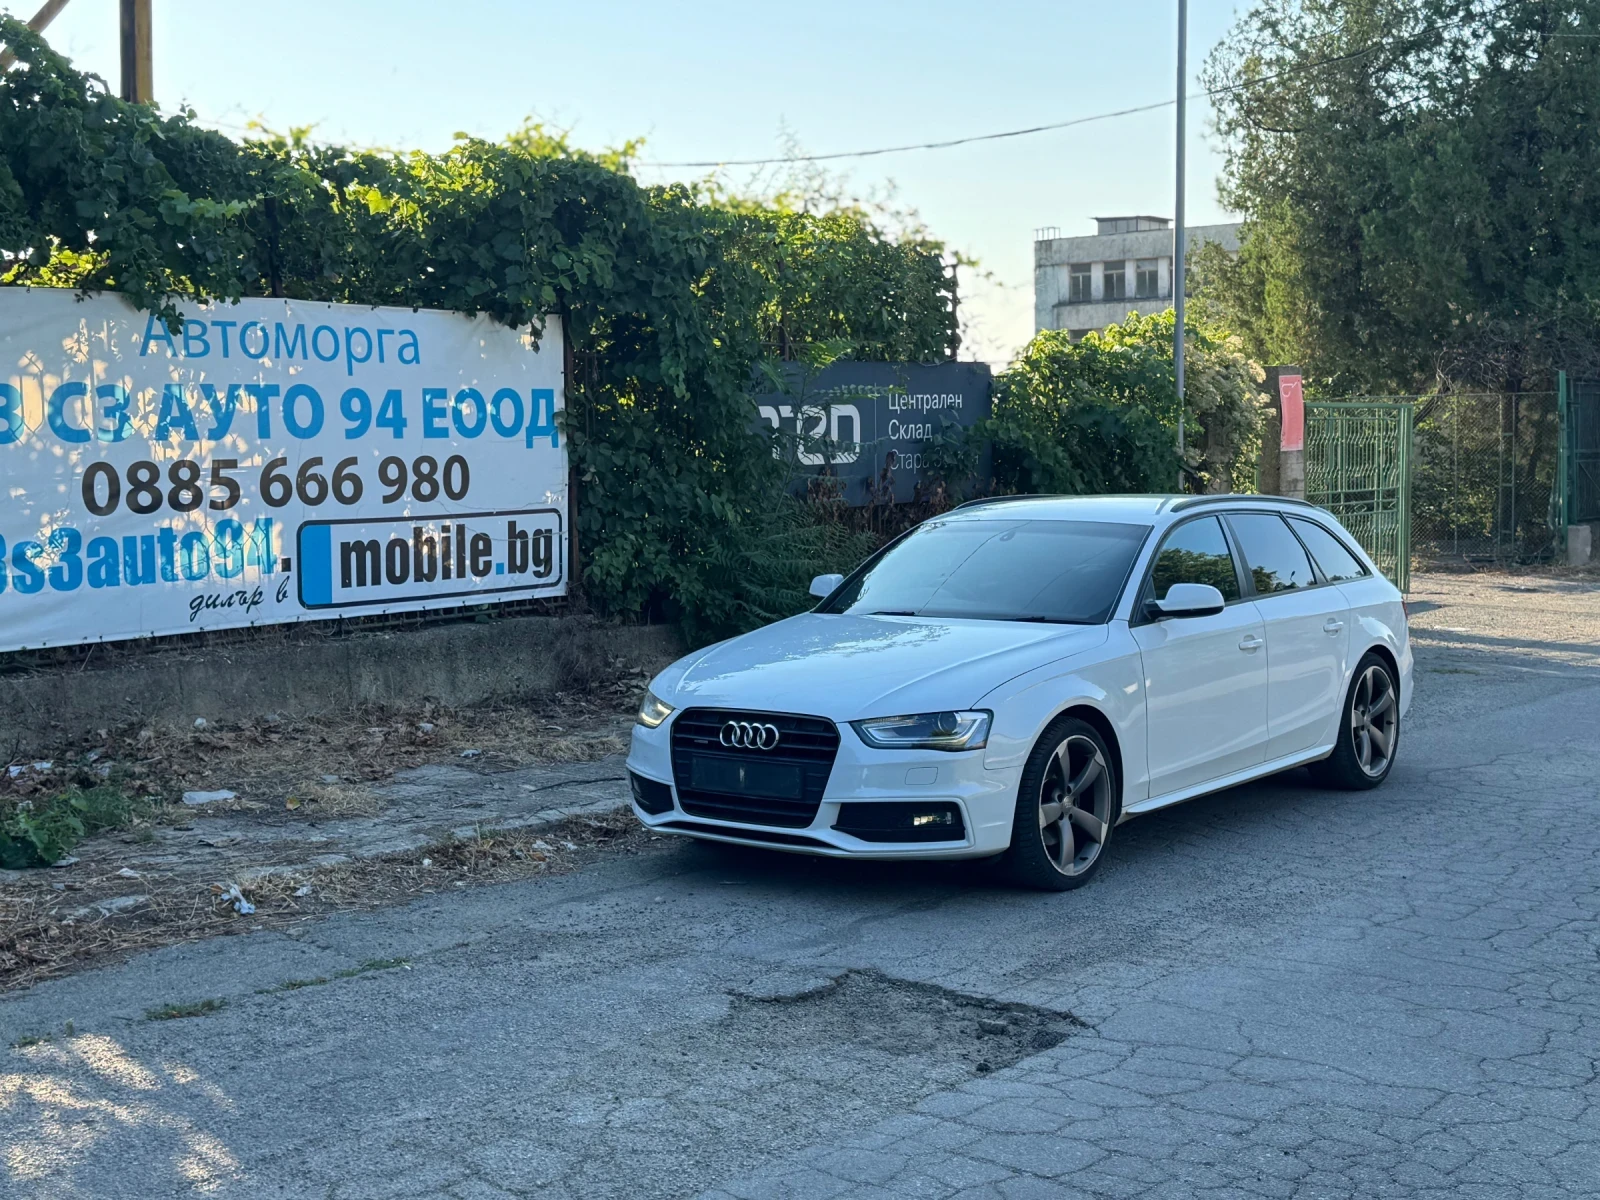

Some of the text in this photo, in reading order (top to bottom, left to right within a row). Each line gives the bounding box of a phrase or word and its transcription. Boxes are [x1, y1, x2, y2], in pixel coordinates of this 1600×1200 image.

[139, 305, 421, 376] Автоморга
[154, 383, 324, 441] АУТО
[339, 388, 407, 439] 94
[423, 387, 559, 449] ЕООД
[888, 393, 963, 414] Централен
[888, 419, 932, 442] Склад
[82, 454, 470, 516] 0885 666 980
[340, 520, 553, 588] mobile.bg
